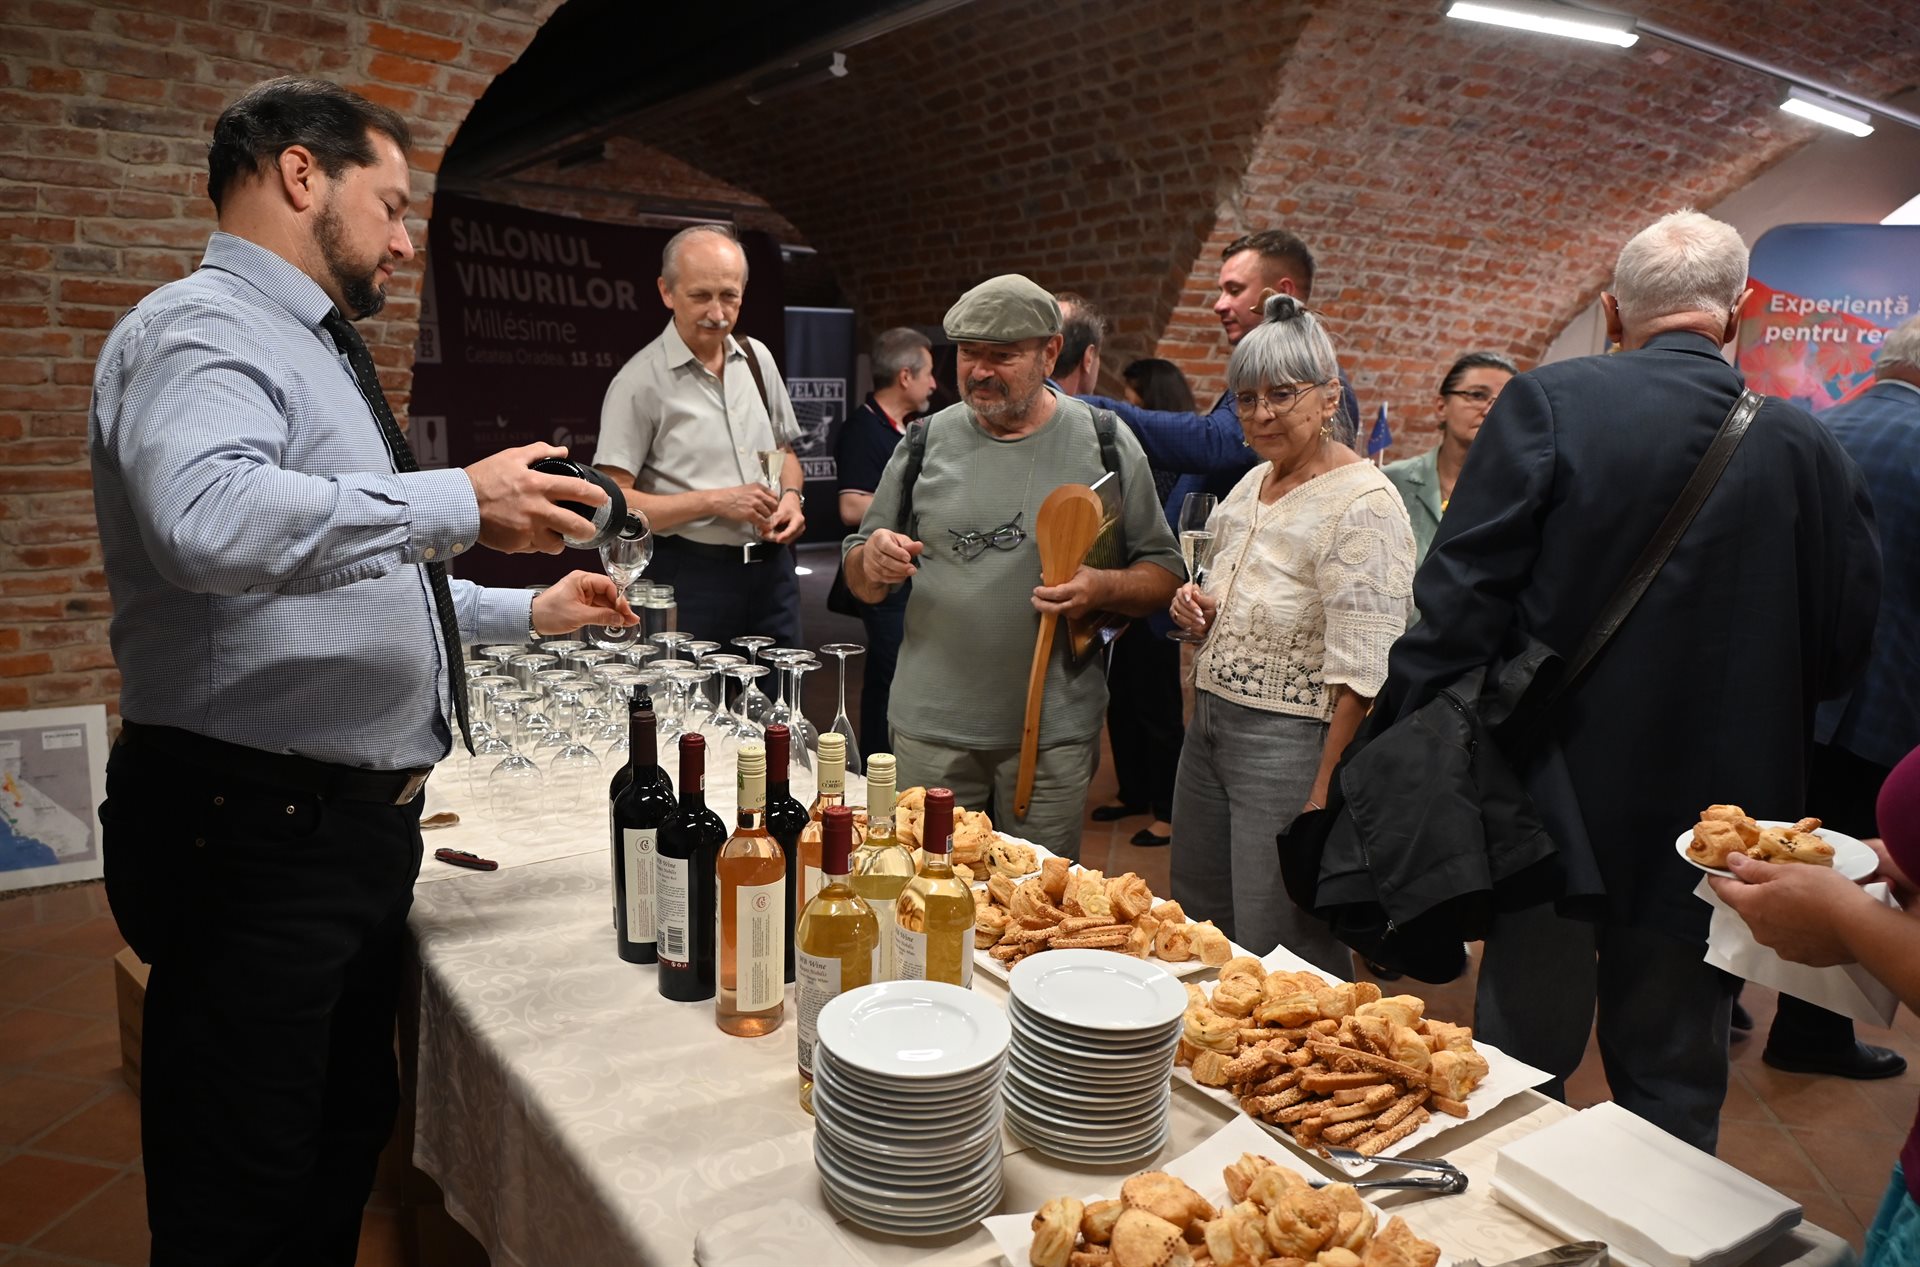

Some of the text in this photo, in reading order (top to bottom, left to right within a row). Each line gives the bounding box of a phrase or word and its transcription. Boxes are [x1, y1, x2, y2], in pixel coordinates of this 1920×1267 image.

[451, 217, 601, 269] SALONUL
[456, 261, 638, 311] VINURILOR
[1770, 294, 1909, 319] Experiență
[464, 308, 576, 343] Millésime
[1765, 324, 1848, 344] pentru
[787, 382, 842, 398] VELVET
[809, 959, 827, 970] Wine
